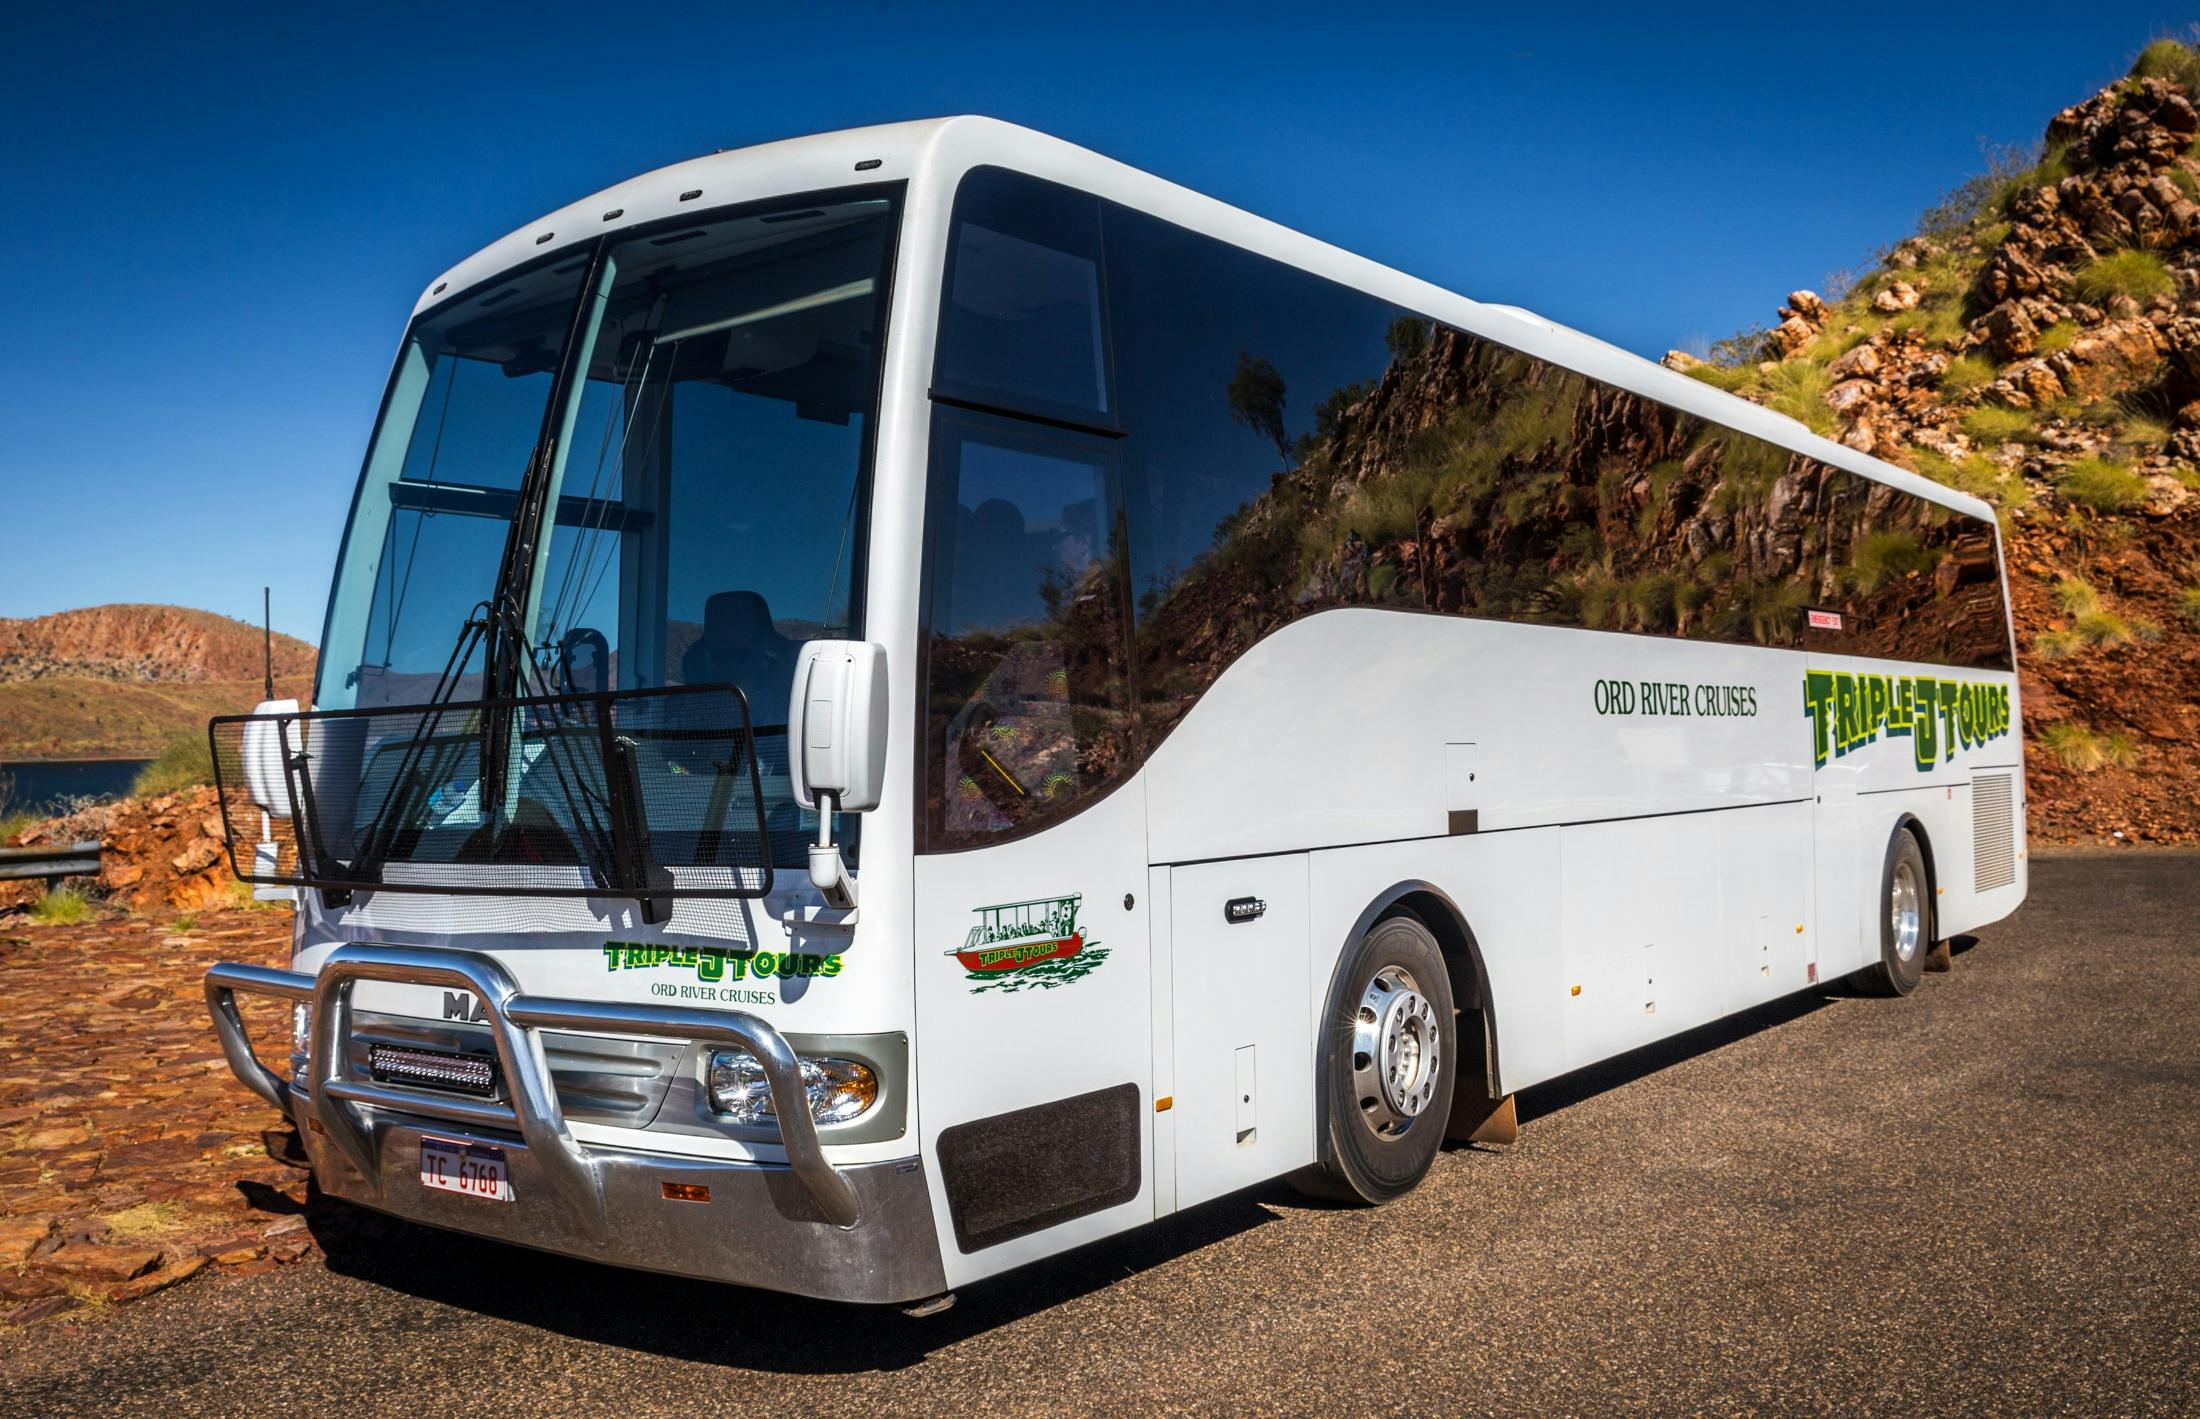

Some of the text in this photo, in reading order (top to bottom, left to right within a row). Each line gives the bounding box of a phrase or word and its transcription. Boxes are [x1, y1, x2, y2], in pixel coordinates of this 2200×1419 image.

[1594, 679, 1757, 717] ORD RIVER CRUISES
[1803, 669, 2010, 772] TRIPLE J TOURS
[603, 941, 846, 982] TRIPLE J TOURS
[979, 949, 1015, 966] TRIPLE
[1025, 942, 1058, 960] TOURS
[443, 991, 492, 1023] MA
[651, 982, 775, 1005] ORD RIVER CRUISES
[427, 1154, 497, 1195] TC 6768
